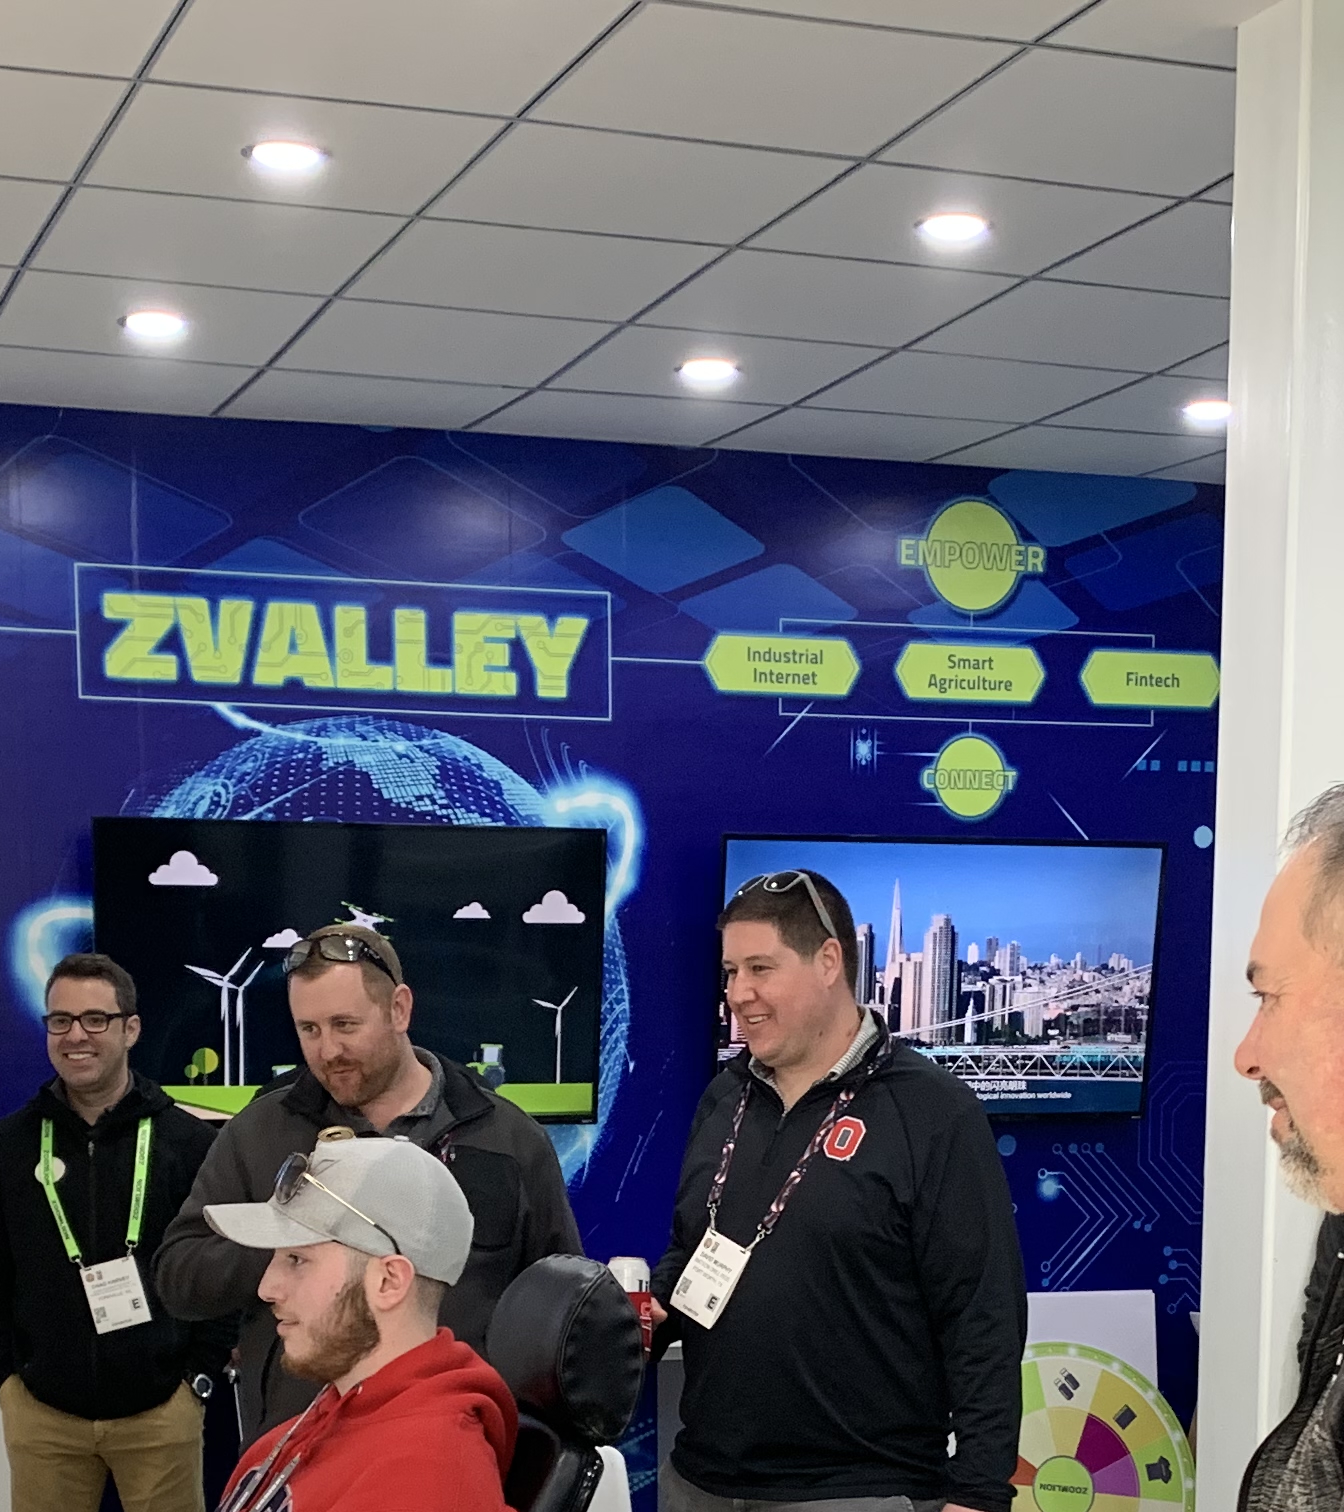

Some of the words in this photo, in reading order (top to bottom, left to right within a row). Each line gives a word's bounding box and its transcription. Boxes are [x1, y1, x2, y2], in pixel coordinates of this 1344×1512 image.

[898, 537, 1045, 574] EMPOWER
[103, 592, 589, 698] ZVALLEY
[746, 645, 824, 666] Industrial
[947, 653, 995, 672] Smart
[752, 667, 819, 687] Internet
[927, 674, 1013, 695] Agriculture
[1125, 671, 1181, 689] Fintech
[921, 767, 1017, 792] CONNECT
[1037, 1091, 1072, 1099] worldwide
[1039, 1481, 1089, 1495] ZOOMLION
